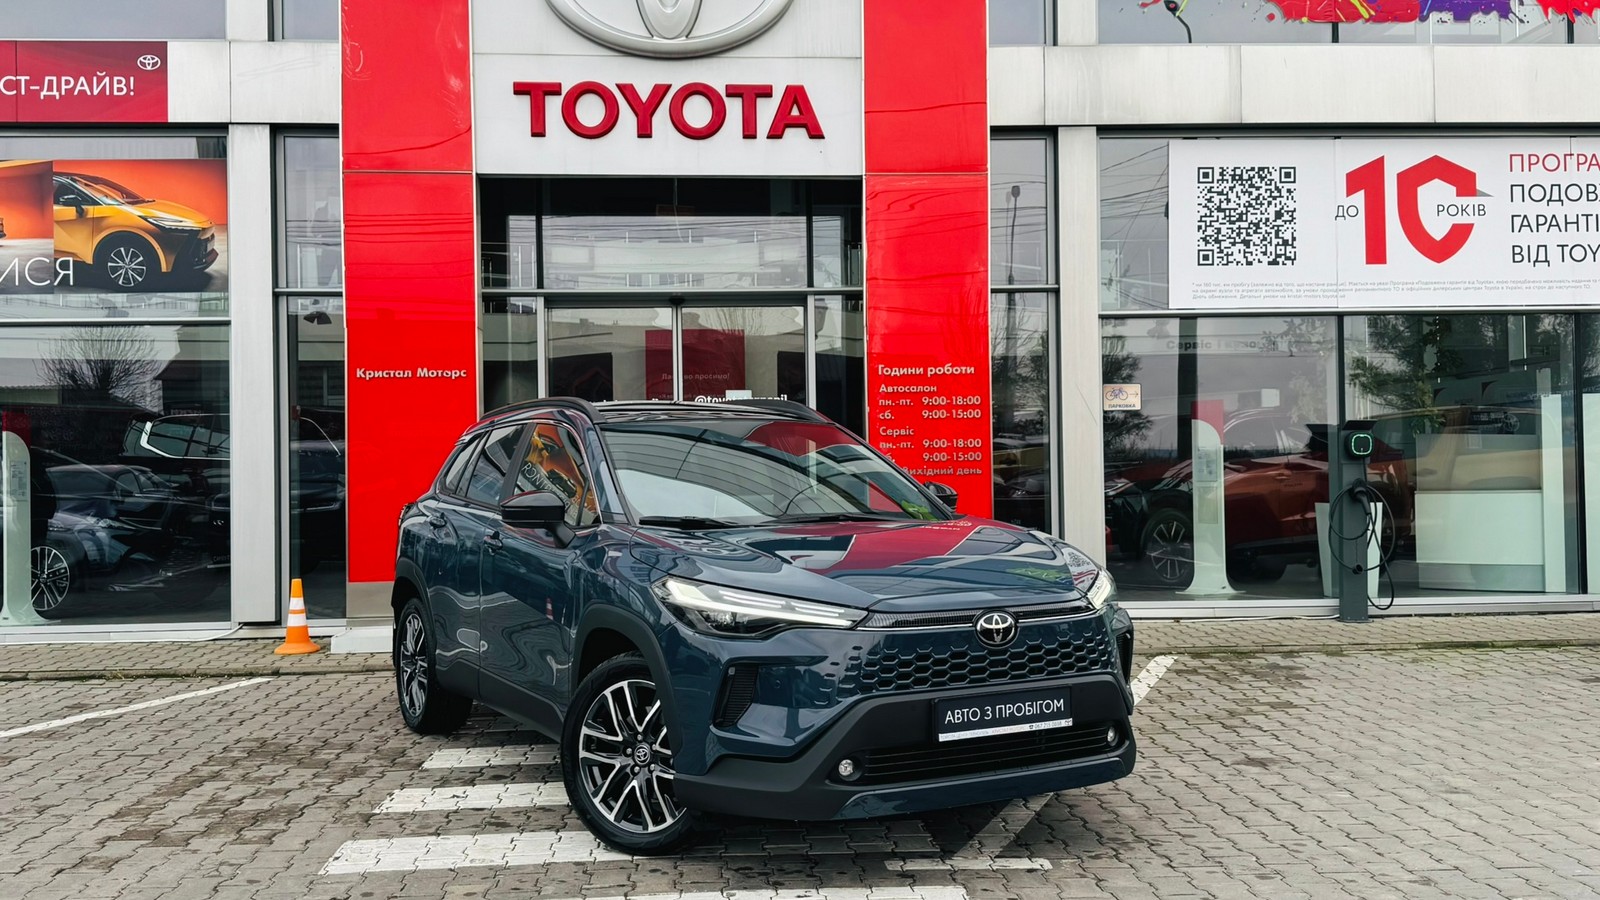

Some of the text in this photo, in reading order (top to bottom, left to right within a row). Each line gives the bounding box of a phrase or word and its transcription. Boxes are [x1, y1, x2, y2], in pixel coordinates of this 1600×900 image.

[0, 71, 134, 100] СТ-ДРАЙВ!
[513, 81, 825, 140] TOYOTA
[1510, 183, 1600, 206] ПОДОВ
[1335, 204, 1359, 221] ДО
[1436, 203, 1486, 217] РОКІВ
[1512, 244, 1550, 267] ВІД
[356, 367, 468, 380] Кристал Моторс
[878, 363, 975, 377] Години роботи
[880, 384, 937, 393] Автосалон
[921, 395, 981, 405] 9:00-18:00
[880, 409, 981, 419] сб. 9:00-15:00
[880, 426, 914, 438] Сервіс
[880, 438, 982, 449] пн.-пт. 9:00-18:00
[922, 452, 982, 462] 9:00-15:00
[956, 466, 982, 476] день
[945, 707, 980, 725] АВТО
[995, 698, 1064, 719] ПРОБІГОМ
